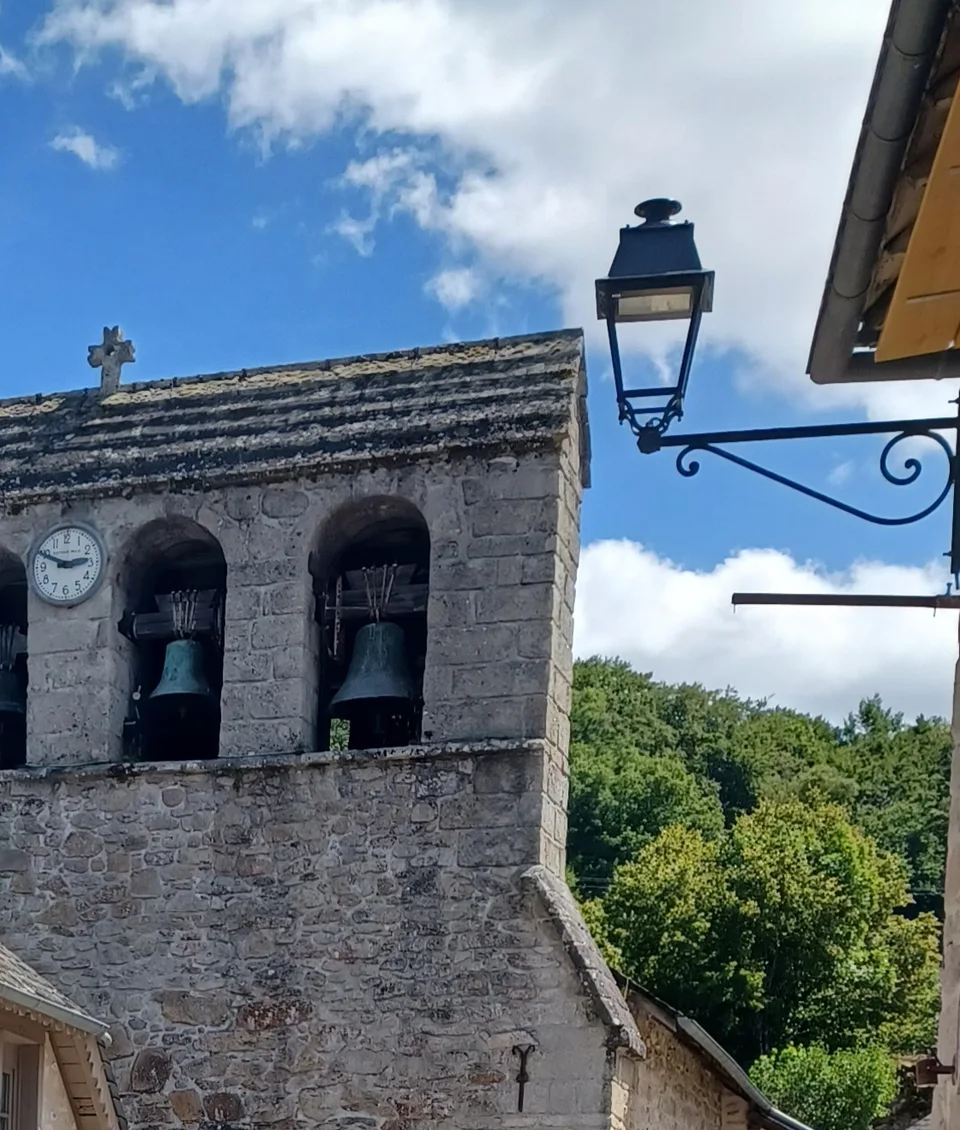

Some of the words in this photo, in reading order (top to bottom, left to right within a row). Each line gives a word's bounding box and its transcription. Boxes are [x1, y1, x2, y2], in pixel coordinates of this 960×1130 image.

[52, 538, 59, 549] 11
[63, 534, 71, 544] 12
[84, 544, 91, 555] 2
[40, 562, 47, 572] 9
[87, 557, 94, 568] 3
[43, 574, 49, 584] 8
[83, 570, 90, 580] 4
[51, 582, 58, 593] 7
[62, 585, 69, 595] 6
[75, 580, 81, 591] 5
